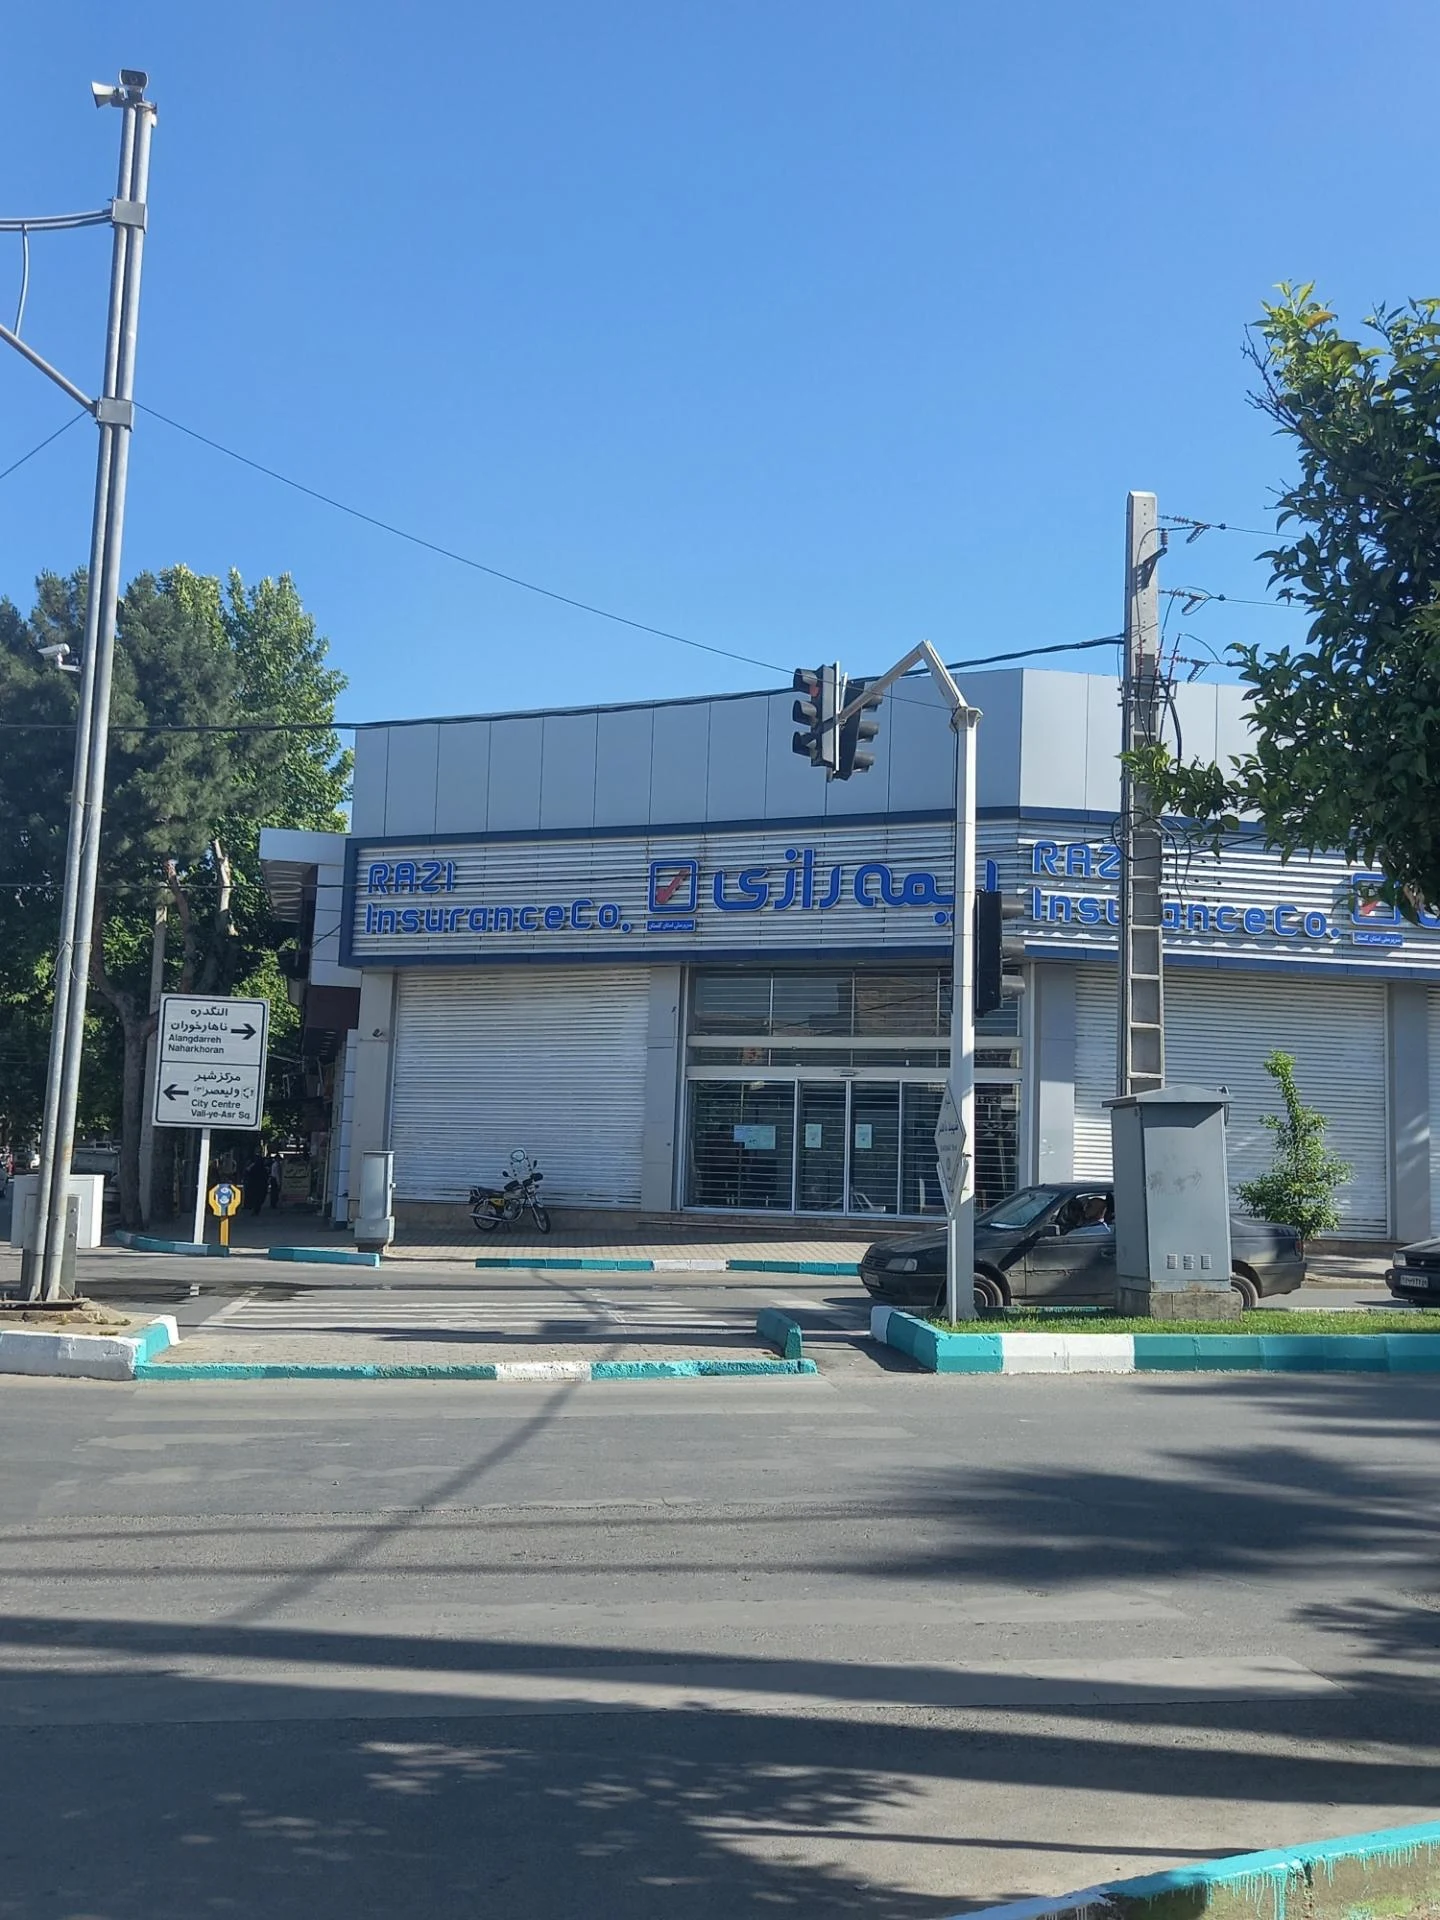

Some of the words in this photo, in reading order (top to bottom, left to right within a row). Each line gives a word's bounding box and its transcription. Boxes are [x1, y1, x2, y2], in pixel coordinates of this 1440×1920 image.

[1032, 840, 1121, 880] RAZ
[367, 860, 455, 894] RAZI
[712, 847, 841, 912] رازی
[853, 857, 998, 925] مه
[1032, 886, 1341, 938] InsanceCo.
[170, 1020, 228, 1033] ناهارخوران
[168, 1034, 222, 1044] Alangdarreh
[168, 1044, 225, 1054] Naharkhoran
[194, 1071, 217, 1082] شهر
[216, 1072, 241, 1084] مرکز
[202, 1087, 240, 1098] ولیعصر
[191, 1099, 209, 1109] City
[211, 1100, 241, 1109] Centre
[191, 1109, 236, 1119] Vali-ye-Asr
[238, 1111, 250, 1120] Sq
